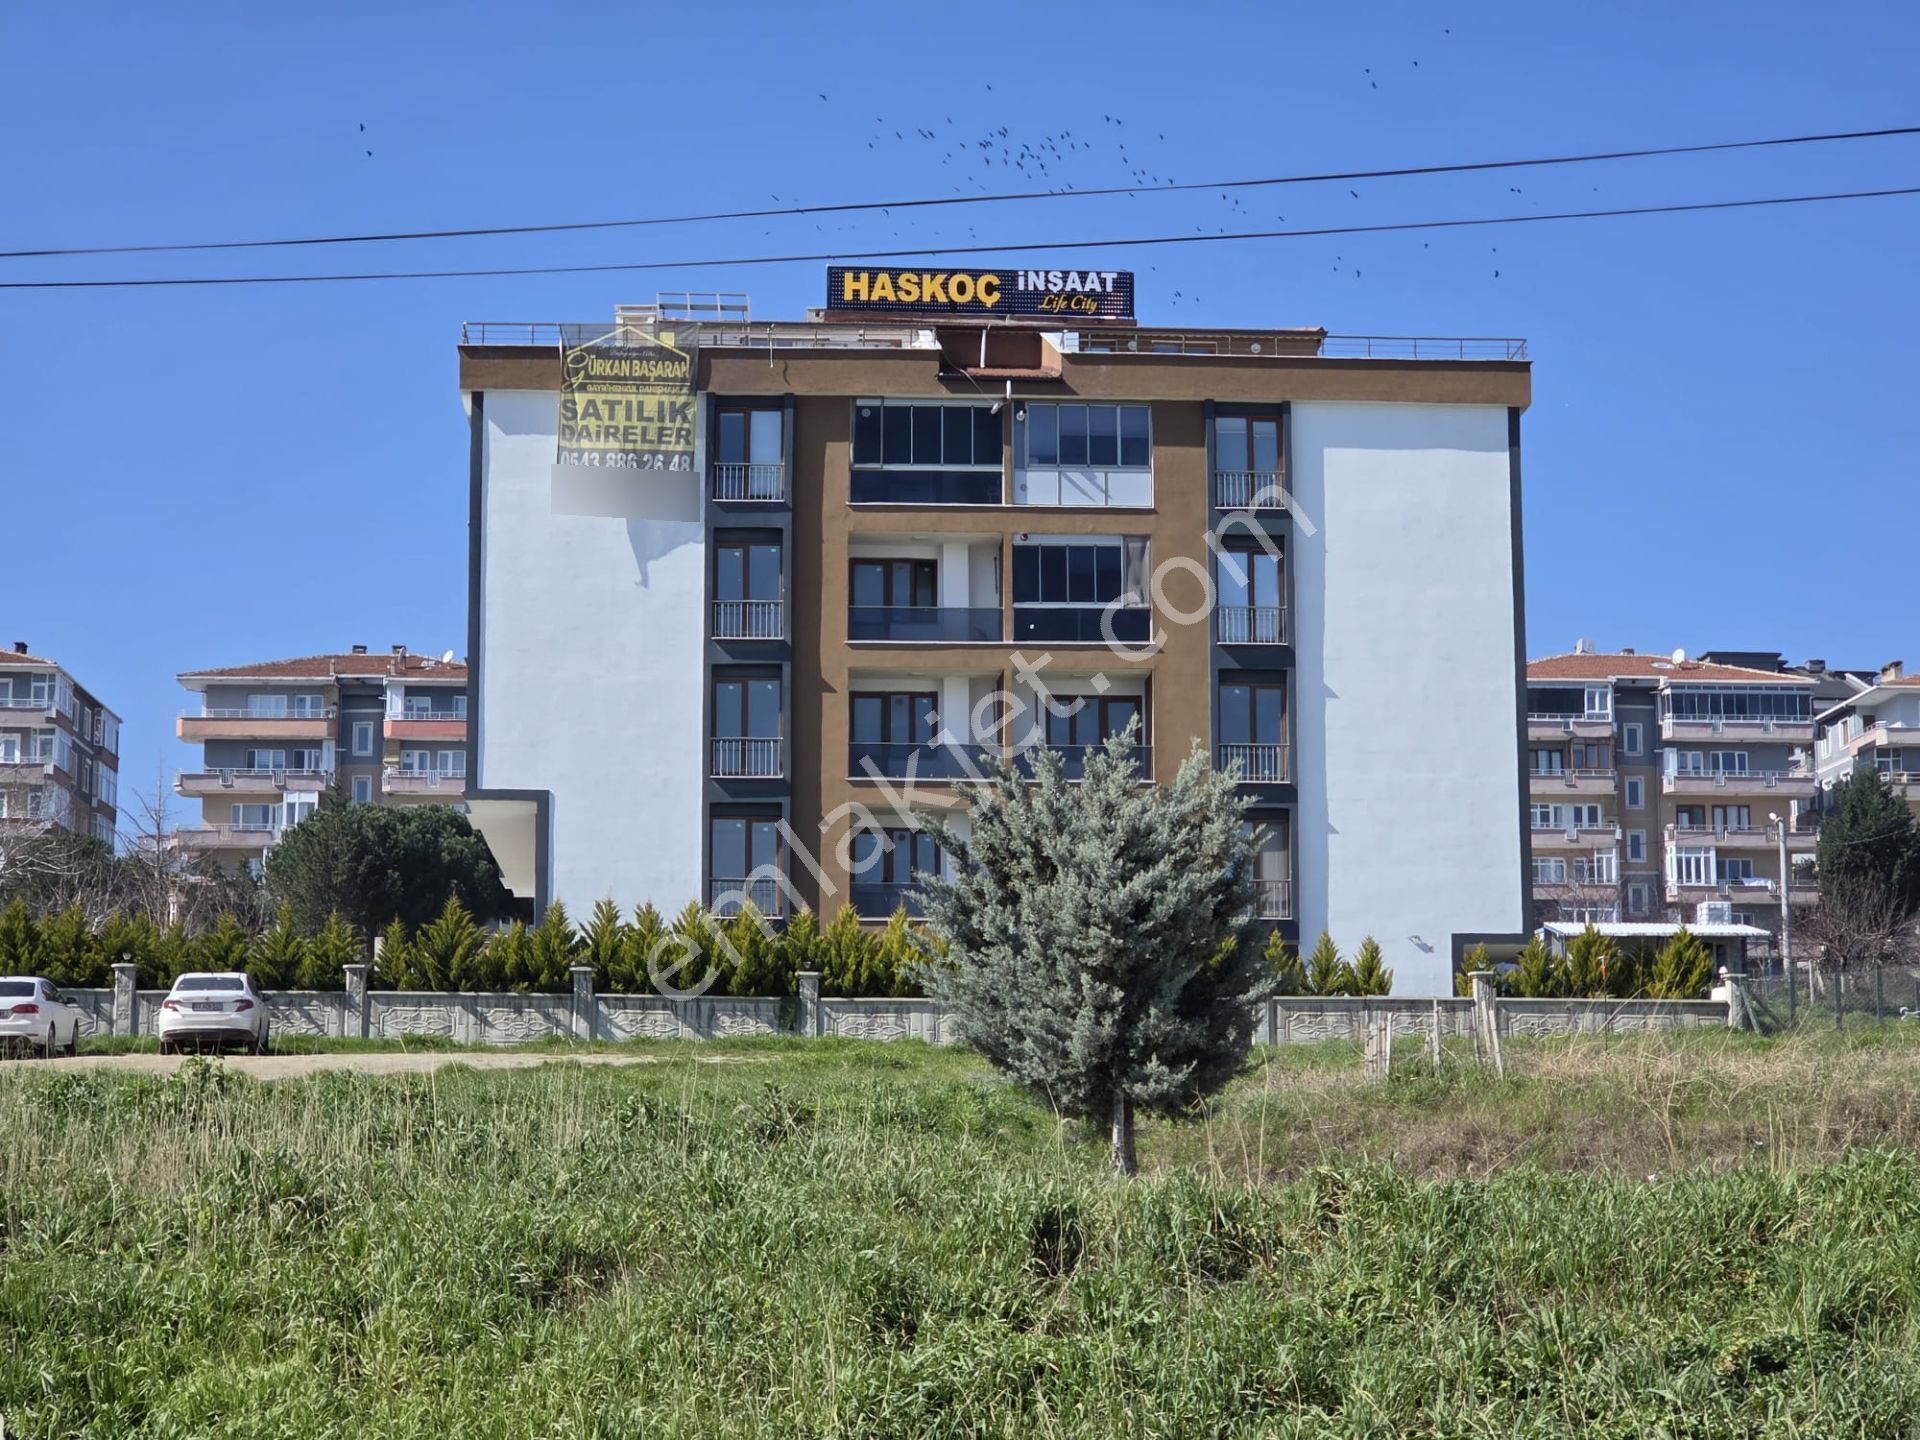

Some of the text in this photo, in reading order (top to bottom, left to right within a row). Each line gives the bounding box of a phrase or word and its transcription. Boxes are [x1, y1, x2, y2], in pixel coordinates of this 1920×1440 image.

[844, 272, 1001, 308] HASKOÇ
[1038, 294, 1098, 314] Life City
[561, 398, 692, 423] SATILIK
